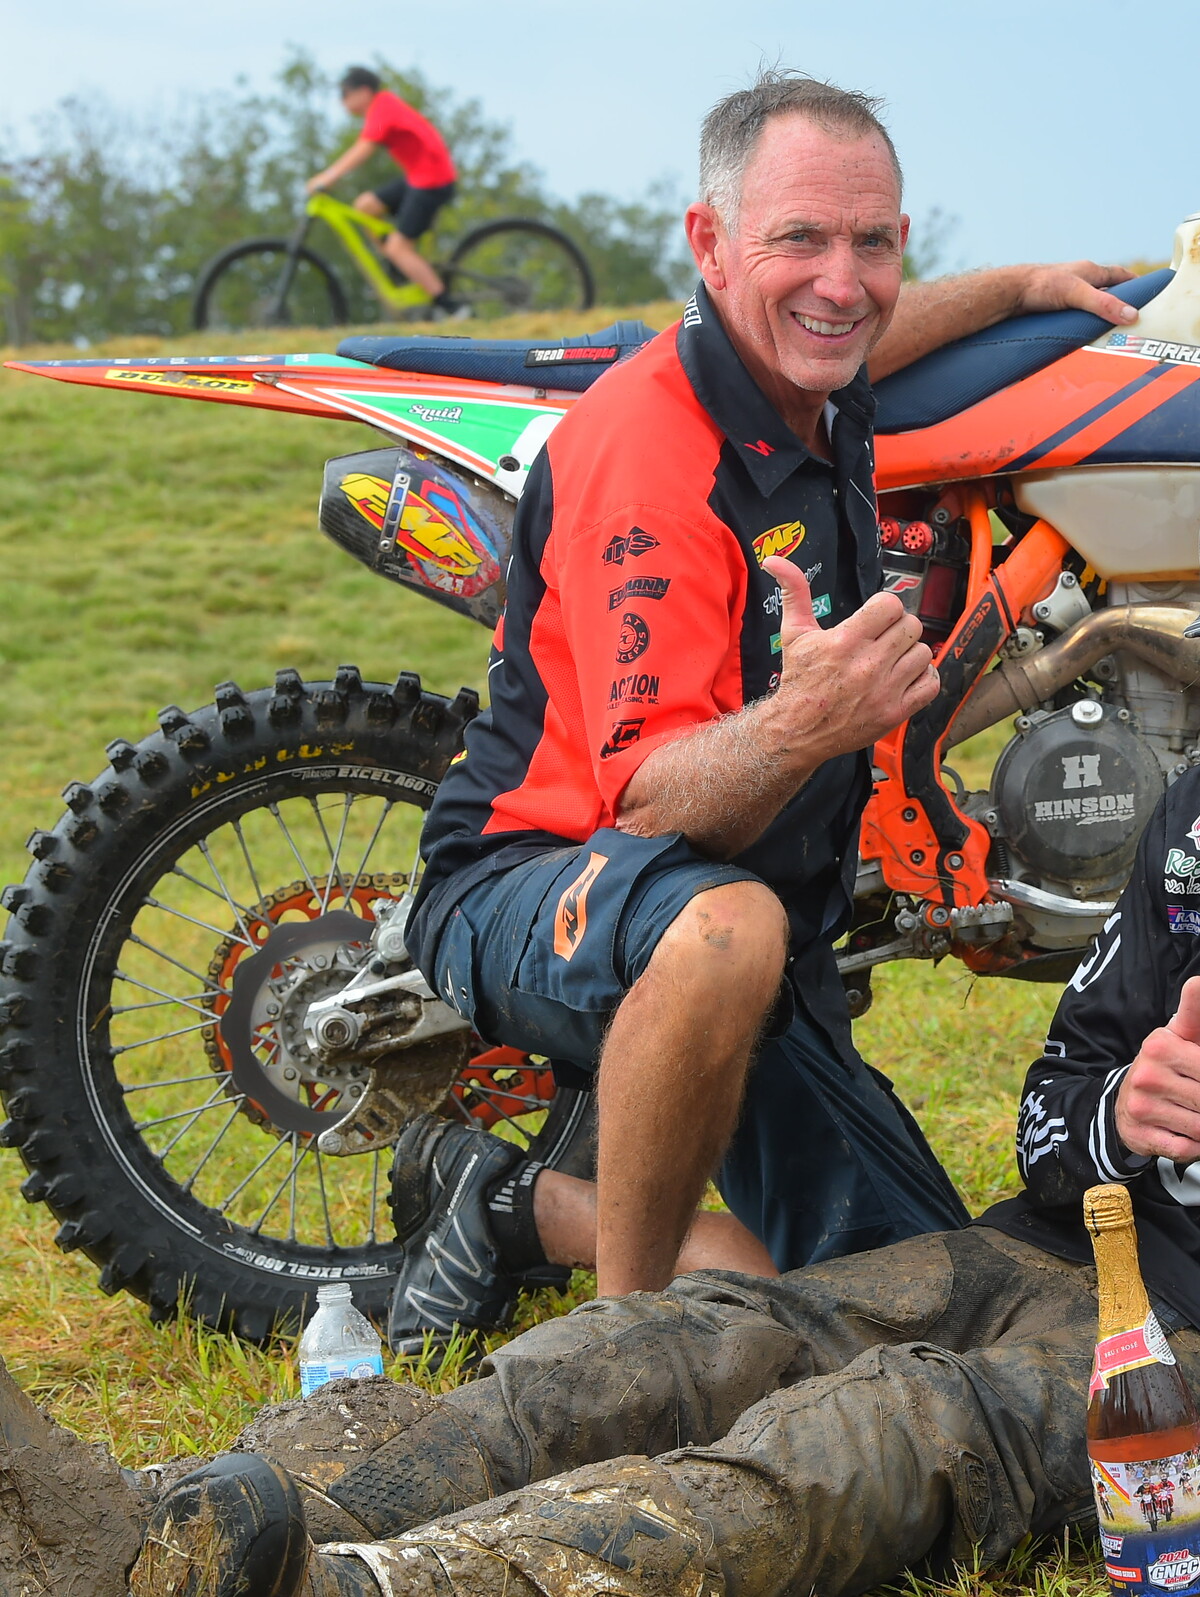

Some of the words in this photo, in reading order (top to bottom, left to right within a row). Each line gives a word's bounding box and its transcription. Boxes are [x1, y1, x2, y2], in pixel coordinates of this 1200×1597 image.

[117, 371, 249, 390] DULOP
[408, 404, 462, 422] Squid
[338, 477, 483, 568] FMF
[753, 520, 801, 563] FMF
[338, 767, 392, 783] EXCEL
[394, 775, 425, 792] A60
[1062, 754, 1102, 790] H
[1034, 794, 1134, 817] HINSON
[255, 1255, 286, 1272] A60
[287, 1262, 343, 1278] EXCEL
[1160, 1549, 1189, 1563] 2020
[1152, 1560, 1198, 1580] GNCC
[1164, 1574, 1191, 1584] RACING
